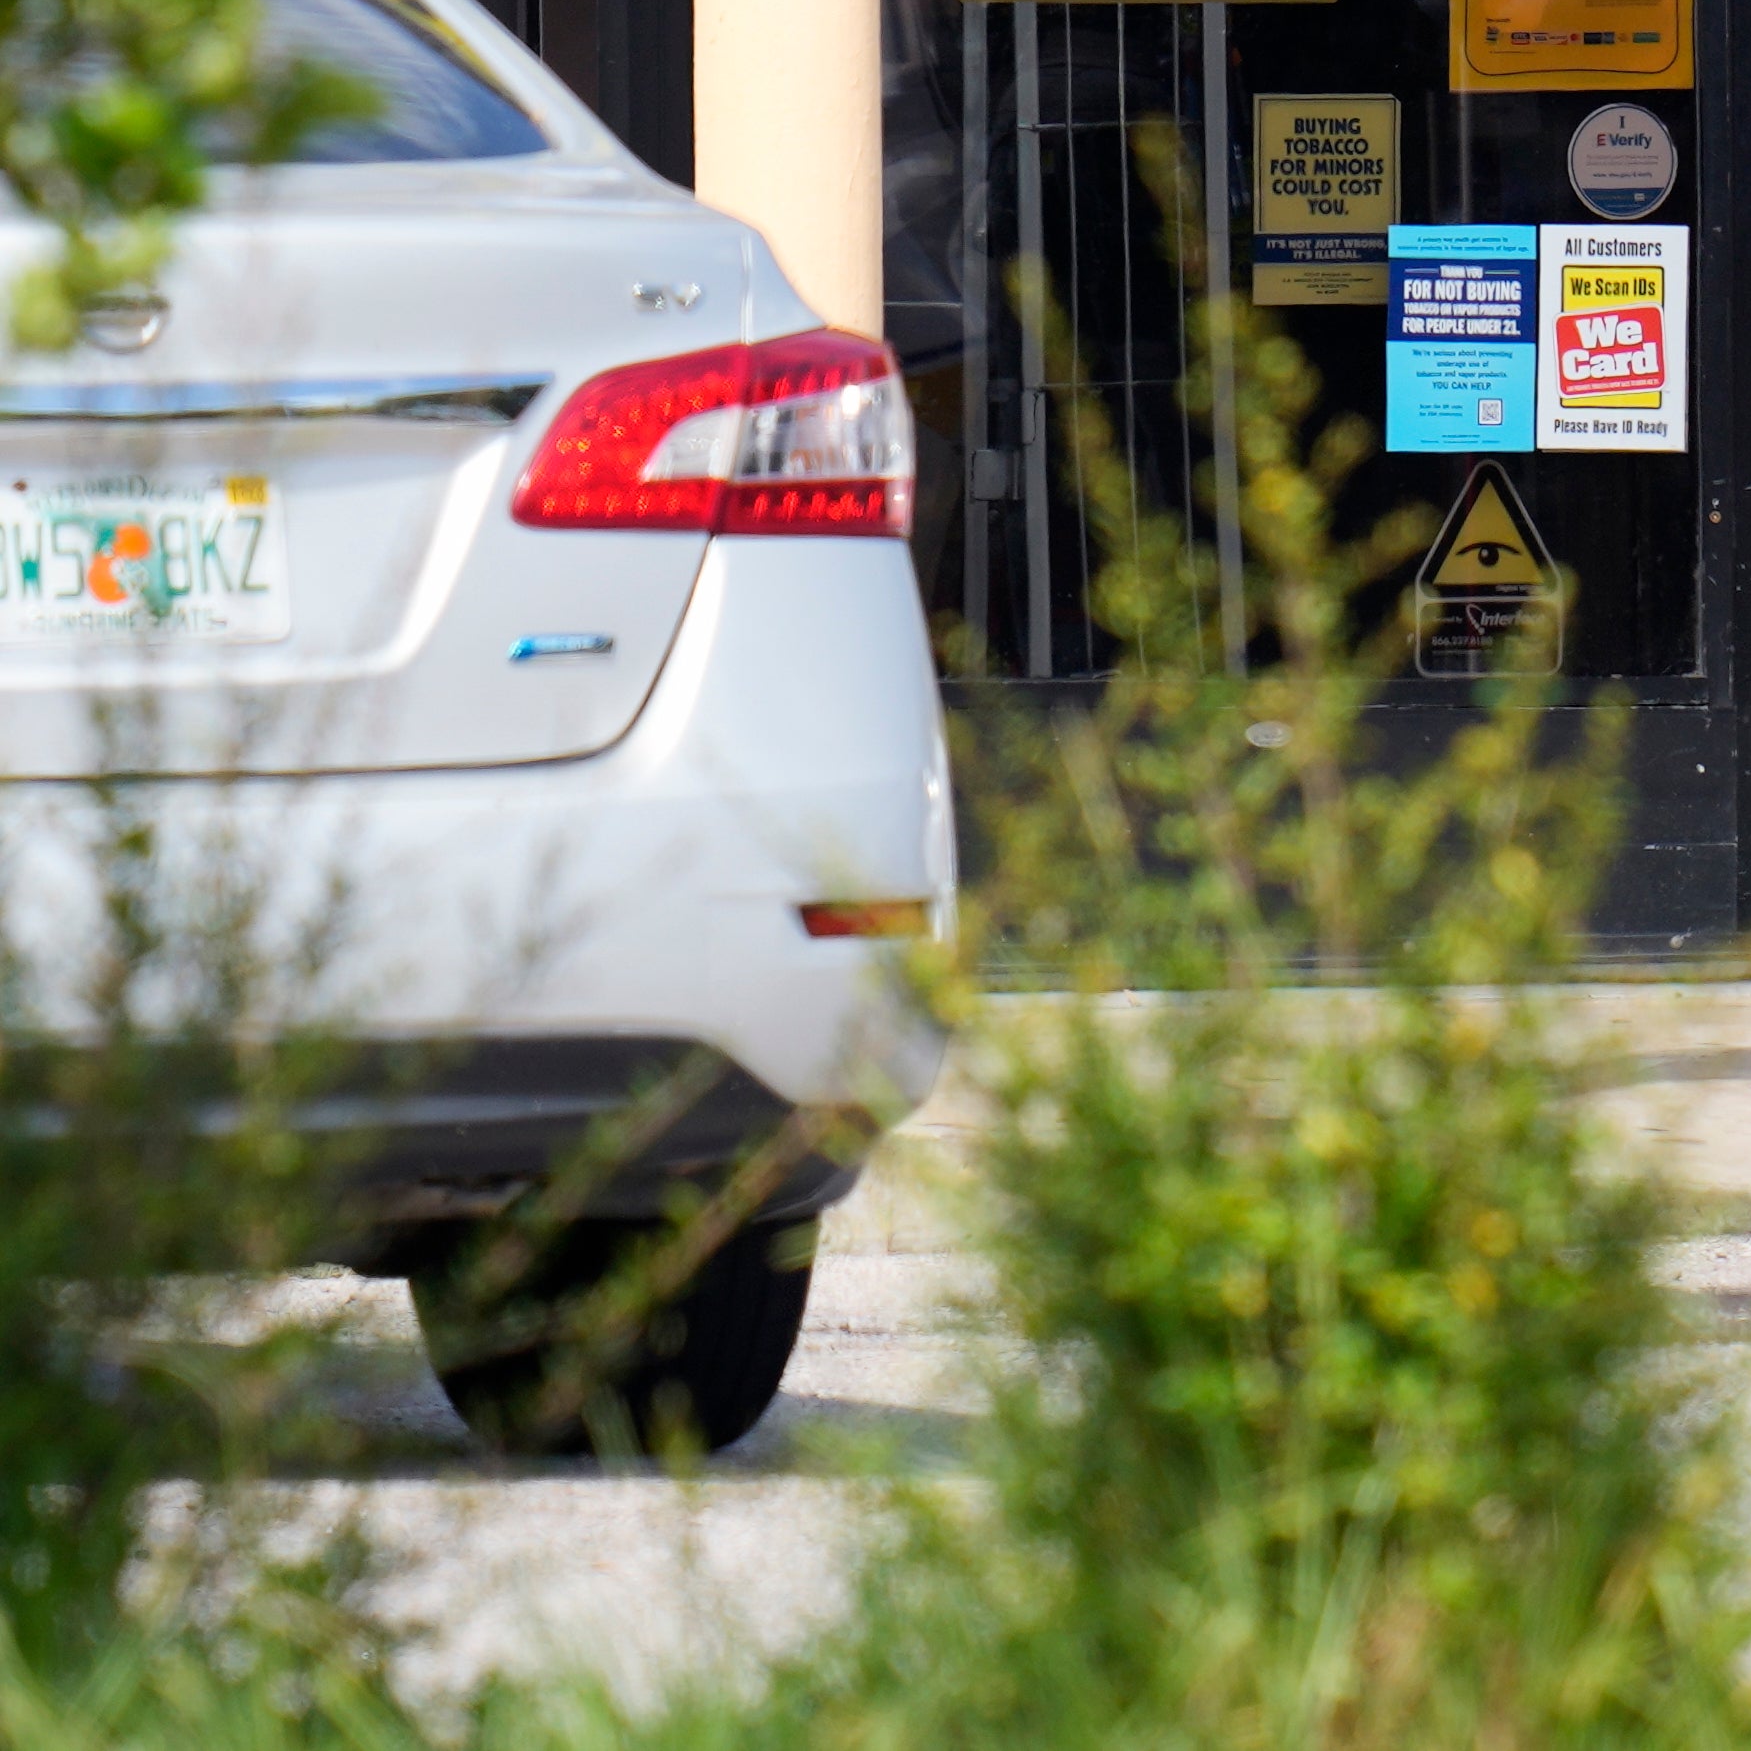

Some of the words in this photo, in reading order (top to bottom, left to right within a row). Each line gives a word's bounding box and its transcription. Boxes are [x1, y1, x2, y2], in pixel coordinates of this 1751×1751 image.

[1294, 118, 1361, 135] BUYING
[1619, 116, 1625, 129] I
[1284, 138, 1368, 155] TOBACCO
[1270, 159, 1306, 175] FOR
[1314, 159, 1384, 175] MINORS
[1272, 179, 1331, 195] COULD
[1339, 179, 1383, 195] COST
[1307, 200, 1349, 215] YOU.
[1565, 238, 1582, 257] All
[1588, 238, 1662, 257] Customers
[1404, 279, 1432, 300] FOR
[1435, 279, 1464, 300] NOT
[1466, 280, 1522, 301] BUYING
[1570, 277, 1591, 296] We
[1595, 278, 1629, 296] Scan
[1633, 278, 1656, 296] IDs
[1402, 317, 1425, 333] FOR
[1426, 318, 1465, 334] PEOPLE
[1466, 318, 1501, 335] UNDER
[1575, 314, 1643, 349] We
[1562, 342, 1659, 381] Card
[1432, 381, 1448, 390] YOU
[1451, 382, 1468, 390] CAN
[1554, 419, 1588, 434] Please
[1593, 419, 1618, 434] Have
[1622, 420, 1632, 434] ID
[1637, 420, 1668, 438] Ready
